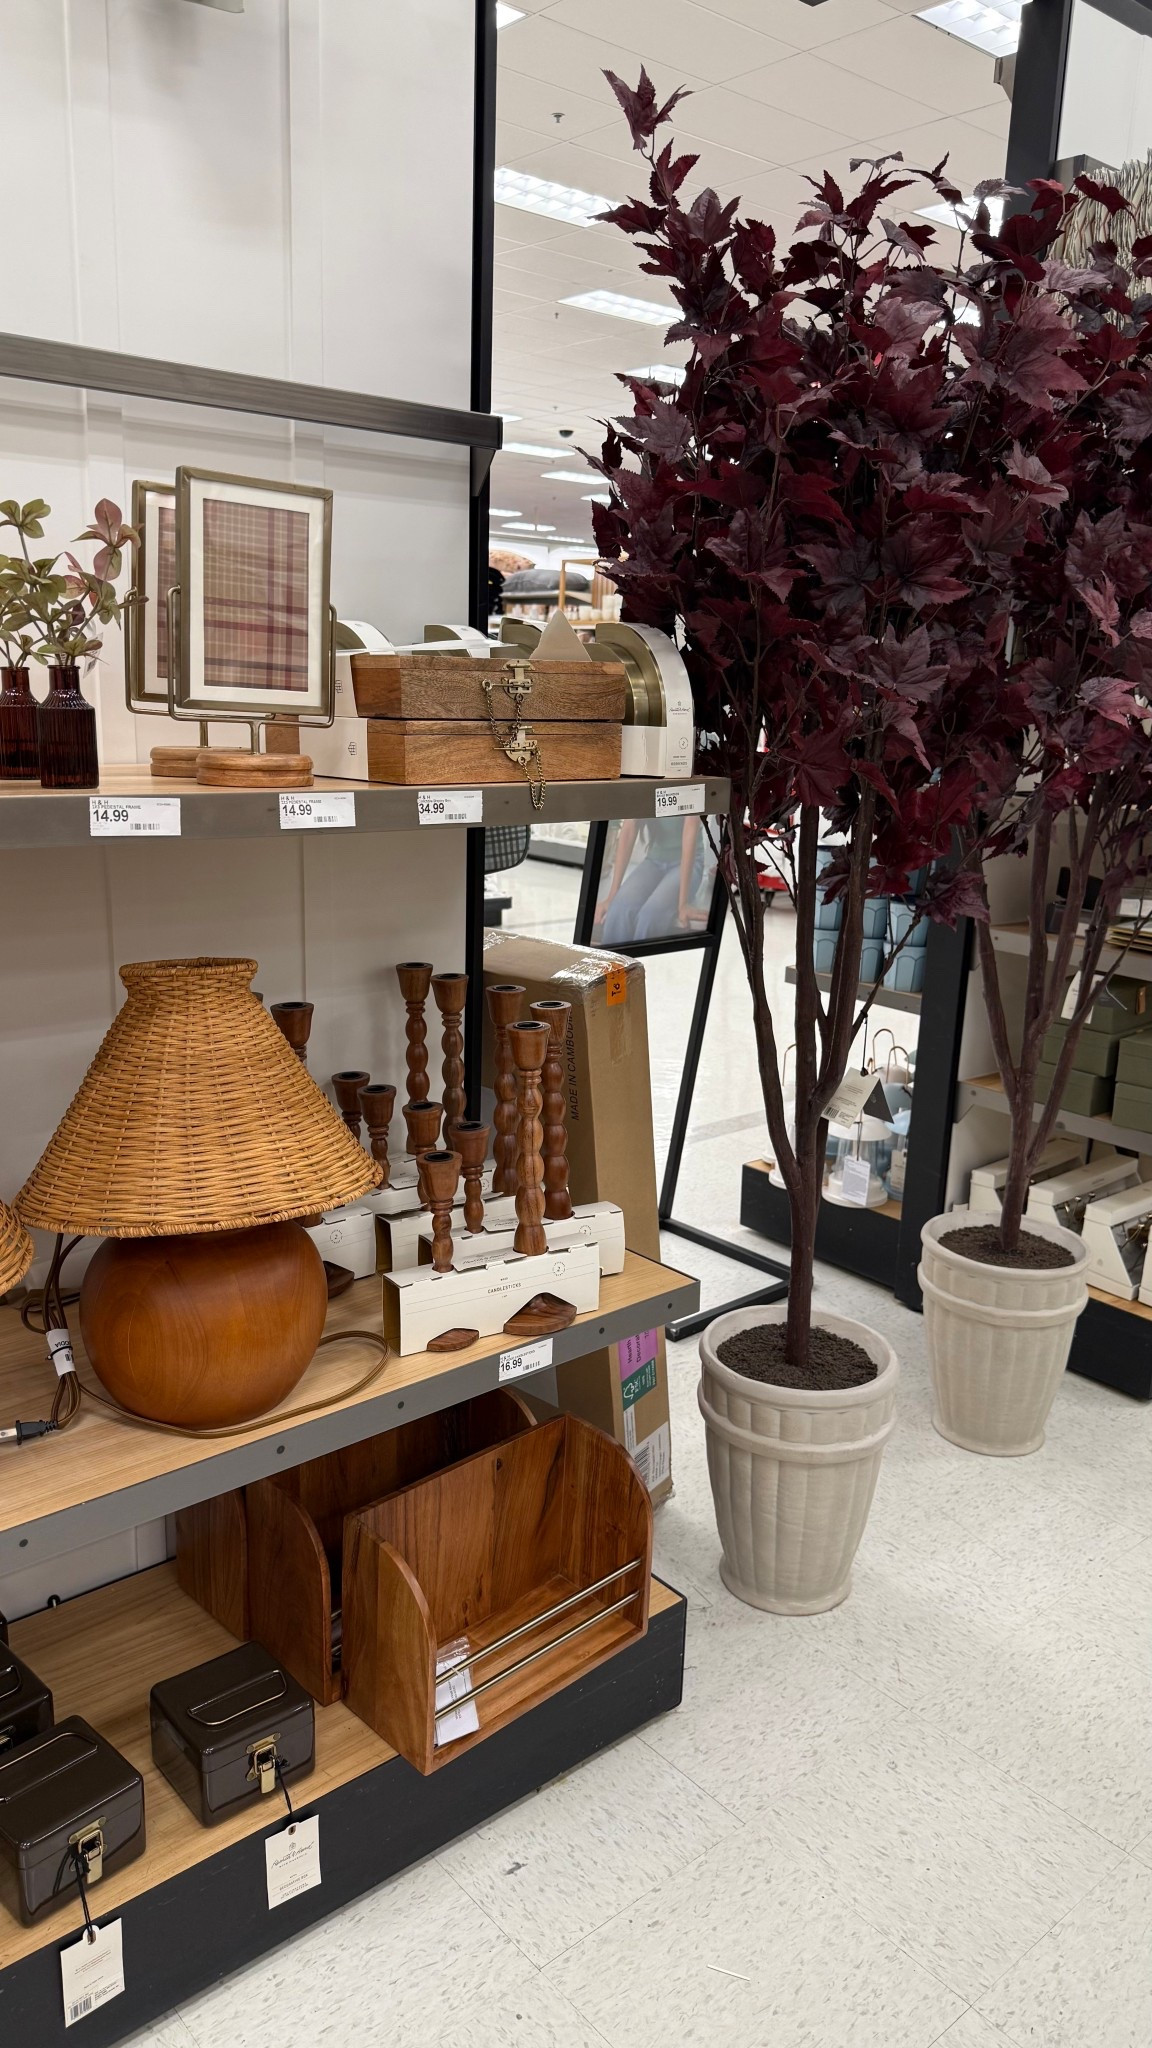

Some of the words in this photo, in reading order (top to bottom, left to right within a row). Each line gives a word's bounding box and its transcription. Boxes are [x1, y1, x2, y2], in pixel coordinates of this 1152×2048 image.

[657, 796, 677, 807] 19.99
[282, 804, 312, 816] 14.99
[419, 802, 444, 814] 34.99
[93, 809, 128, 822] 14.99
[569, 1075, 577, 1087] IN
[570, 1089, 579, 1121] MADE
[487, 1283, 522, 1293] CANDLESTICKS
[501, 1358, 522, 1372] 16.99
